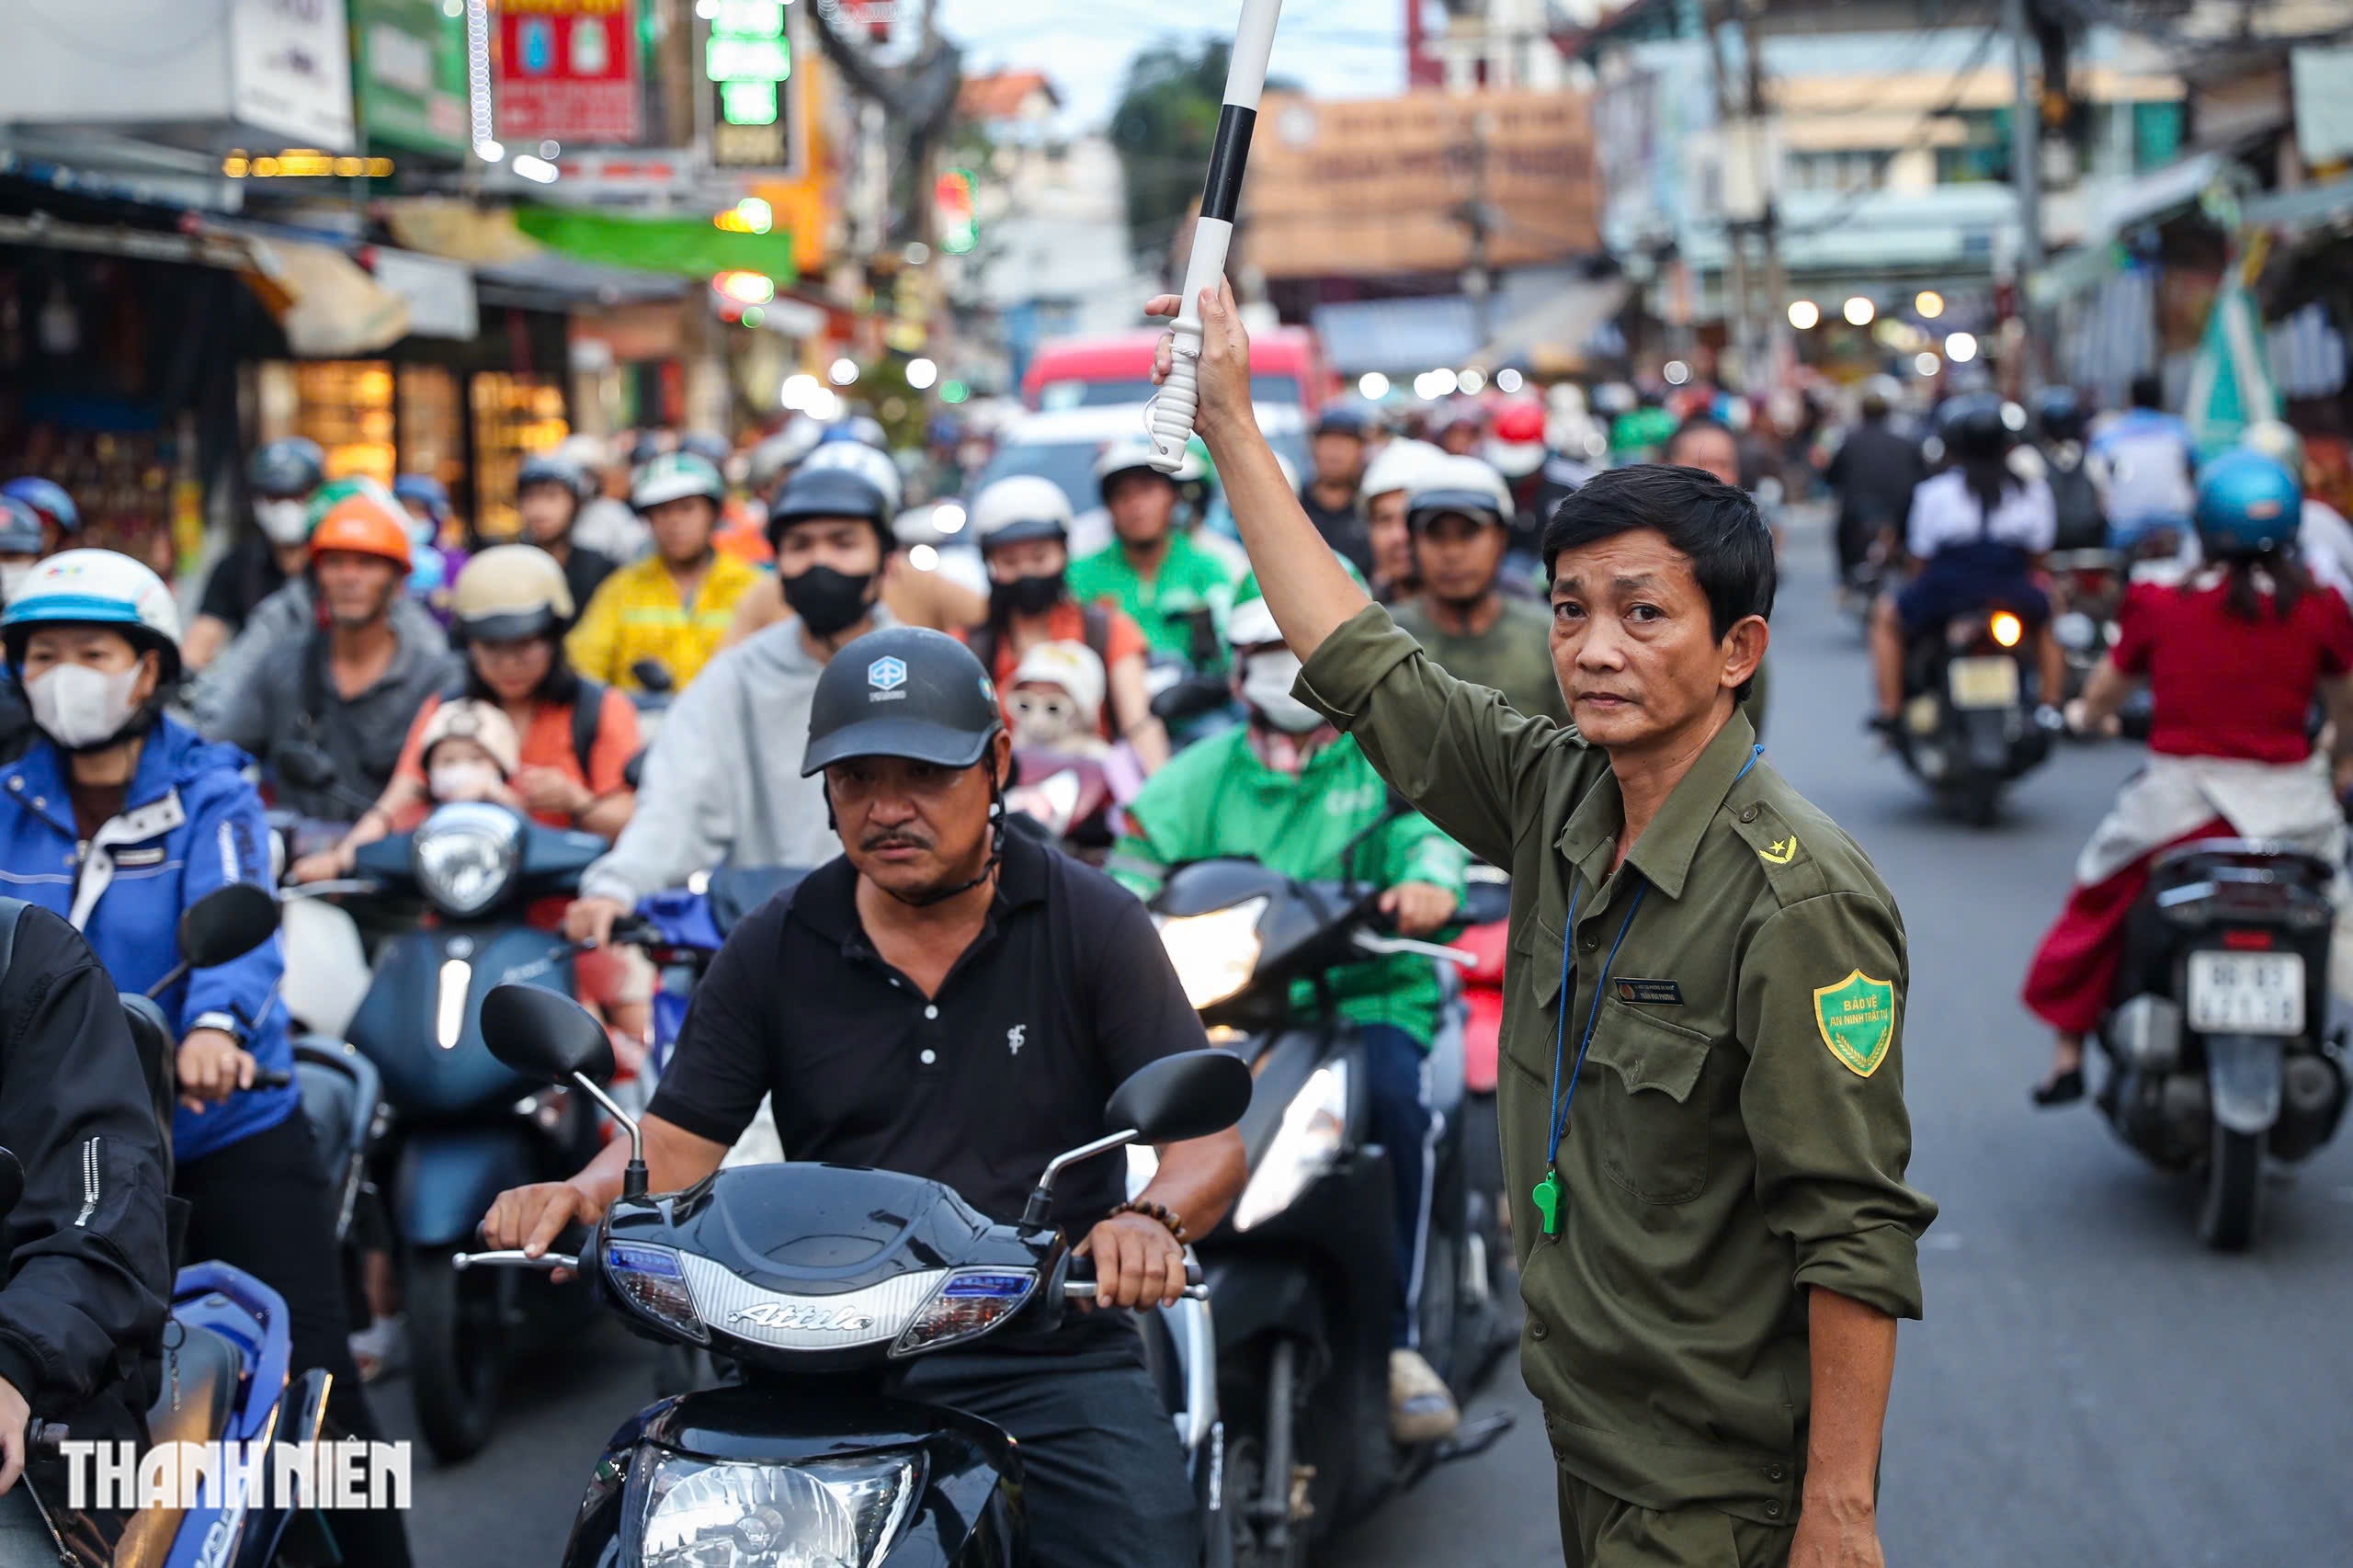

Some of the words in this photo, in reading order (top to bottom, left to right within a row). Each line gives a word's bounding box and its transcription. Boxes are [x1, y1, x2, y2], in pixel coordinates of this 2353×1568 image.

[1843, 996, 1866, 1011] BẢO
[1867, 994, 1877, 1009] VỆ
[1830, 1016, 1843, 1027] AN
[1844, 1013, 1864, 1025] NINH
